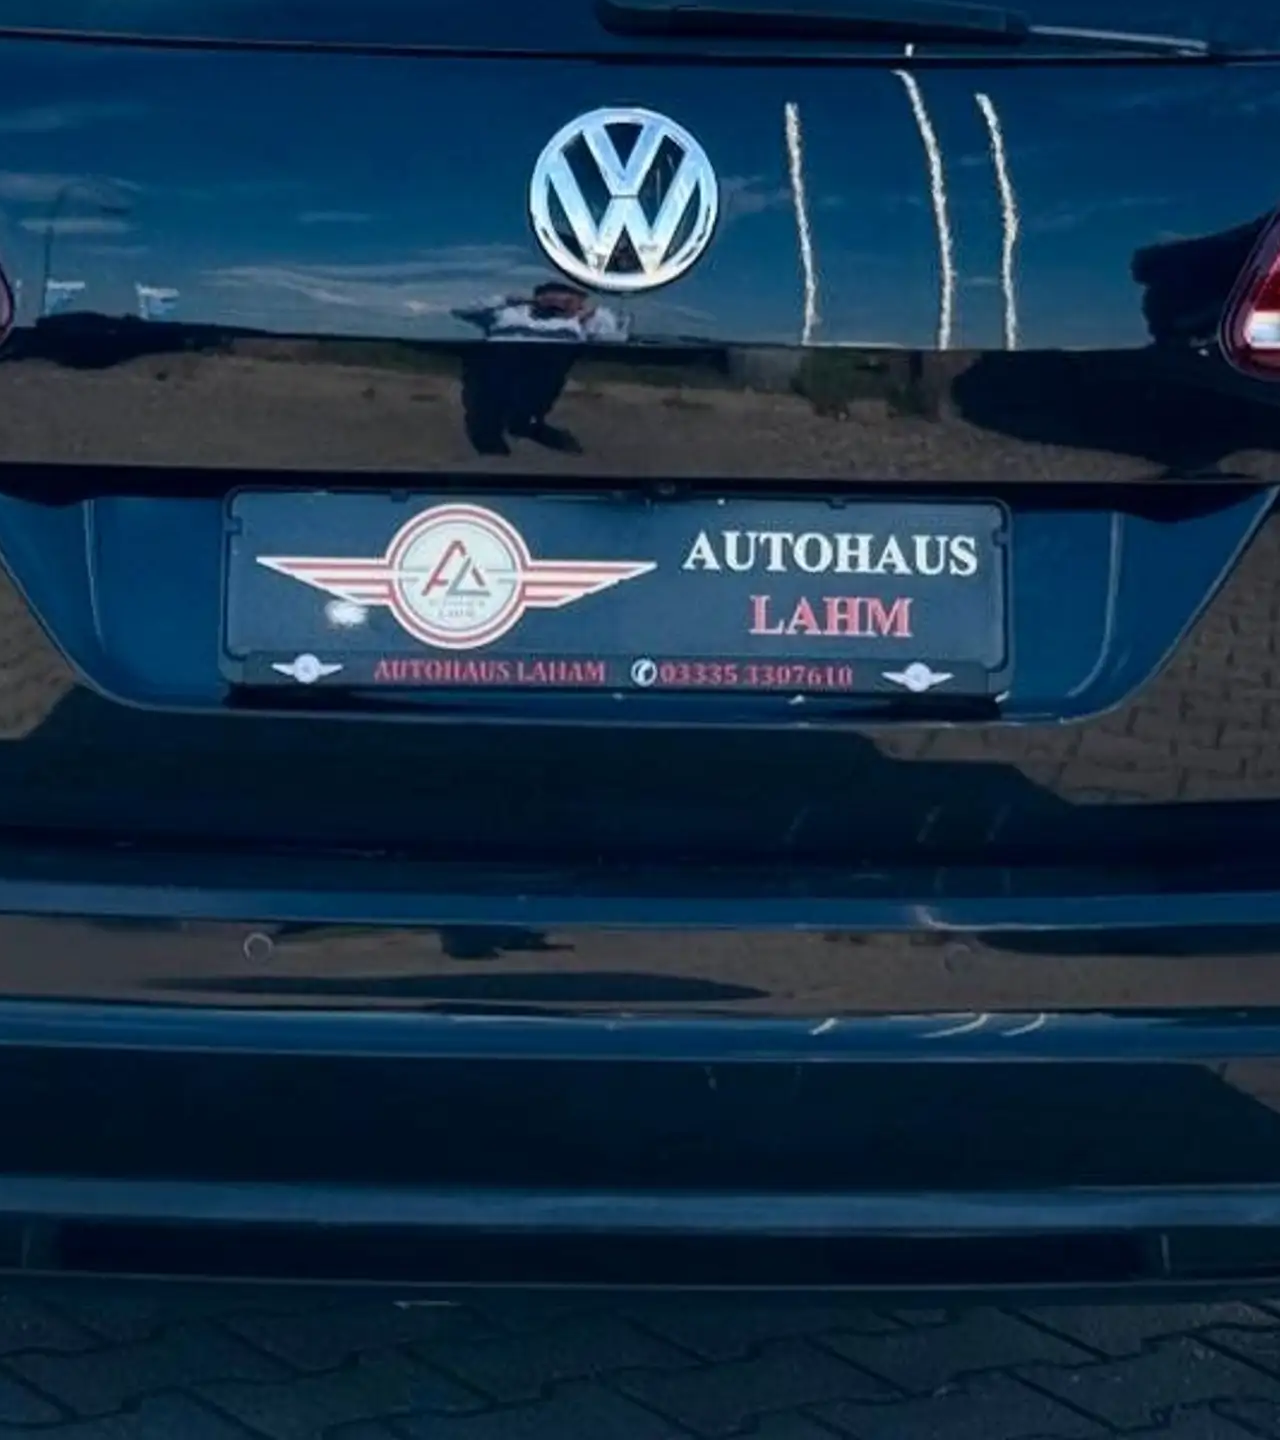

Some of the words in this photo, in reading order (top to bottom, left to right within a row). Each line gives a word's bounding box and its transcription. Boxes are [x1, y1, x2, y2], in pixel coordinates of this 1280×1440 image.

[681, 529, 979, 576] AUTOHAUS
[748, 594, 914, 638] LAHM
[374, 659, 510, 683] AUTOHAUS
[517, 660, 606, 684] LAHAM
[659, 662, 738, 685] 03335
